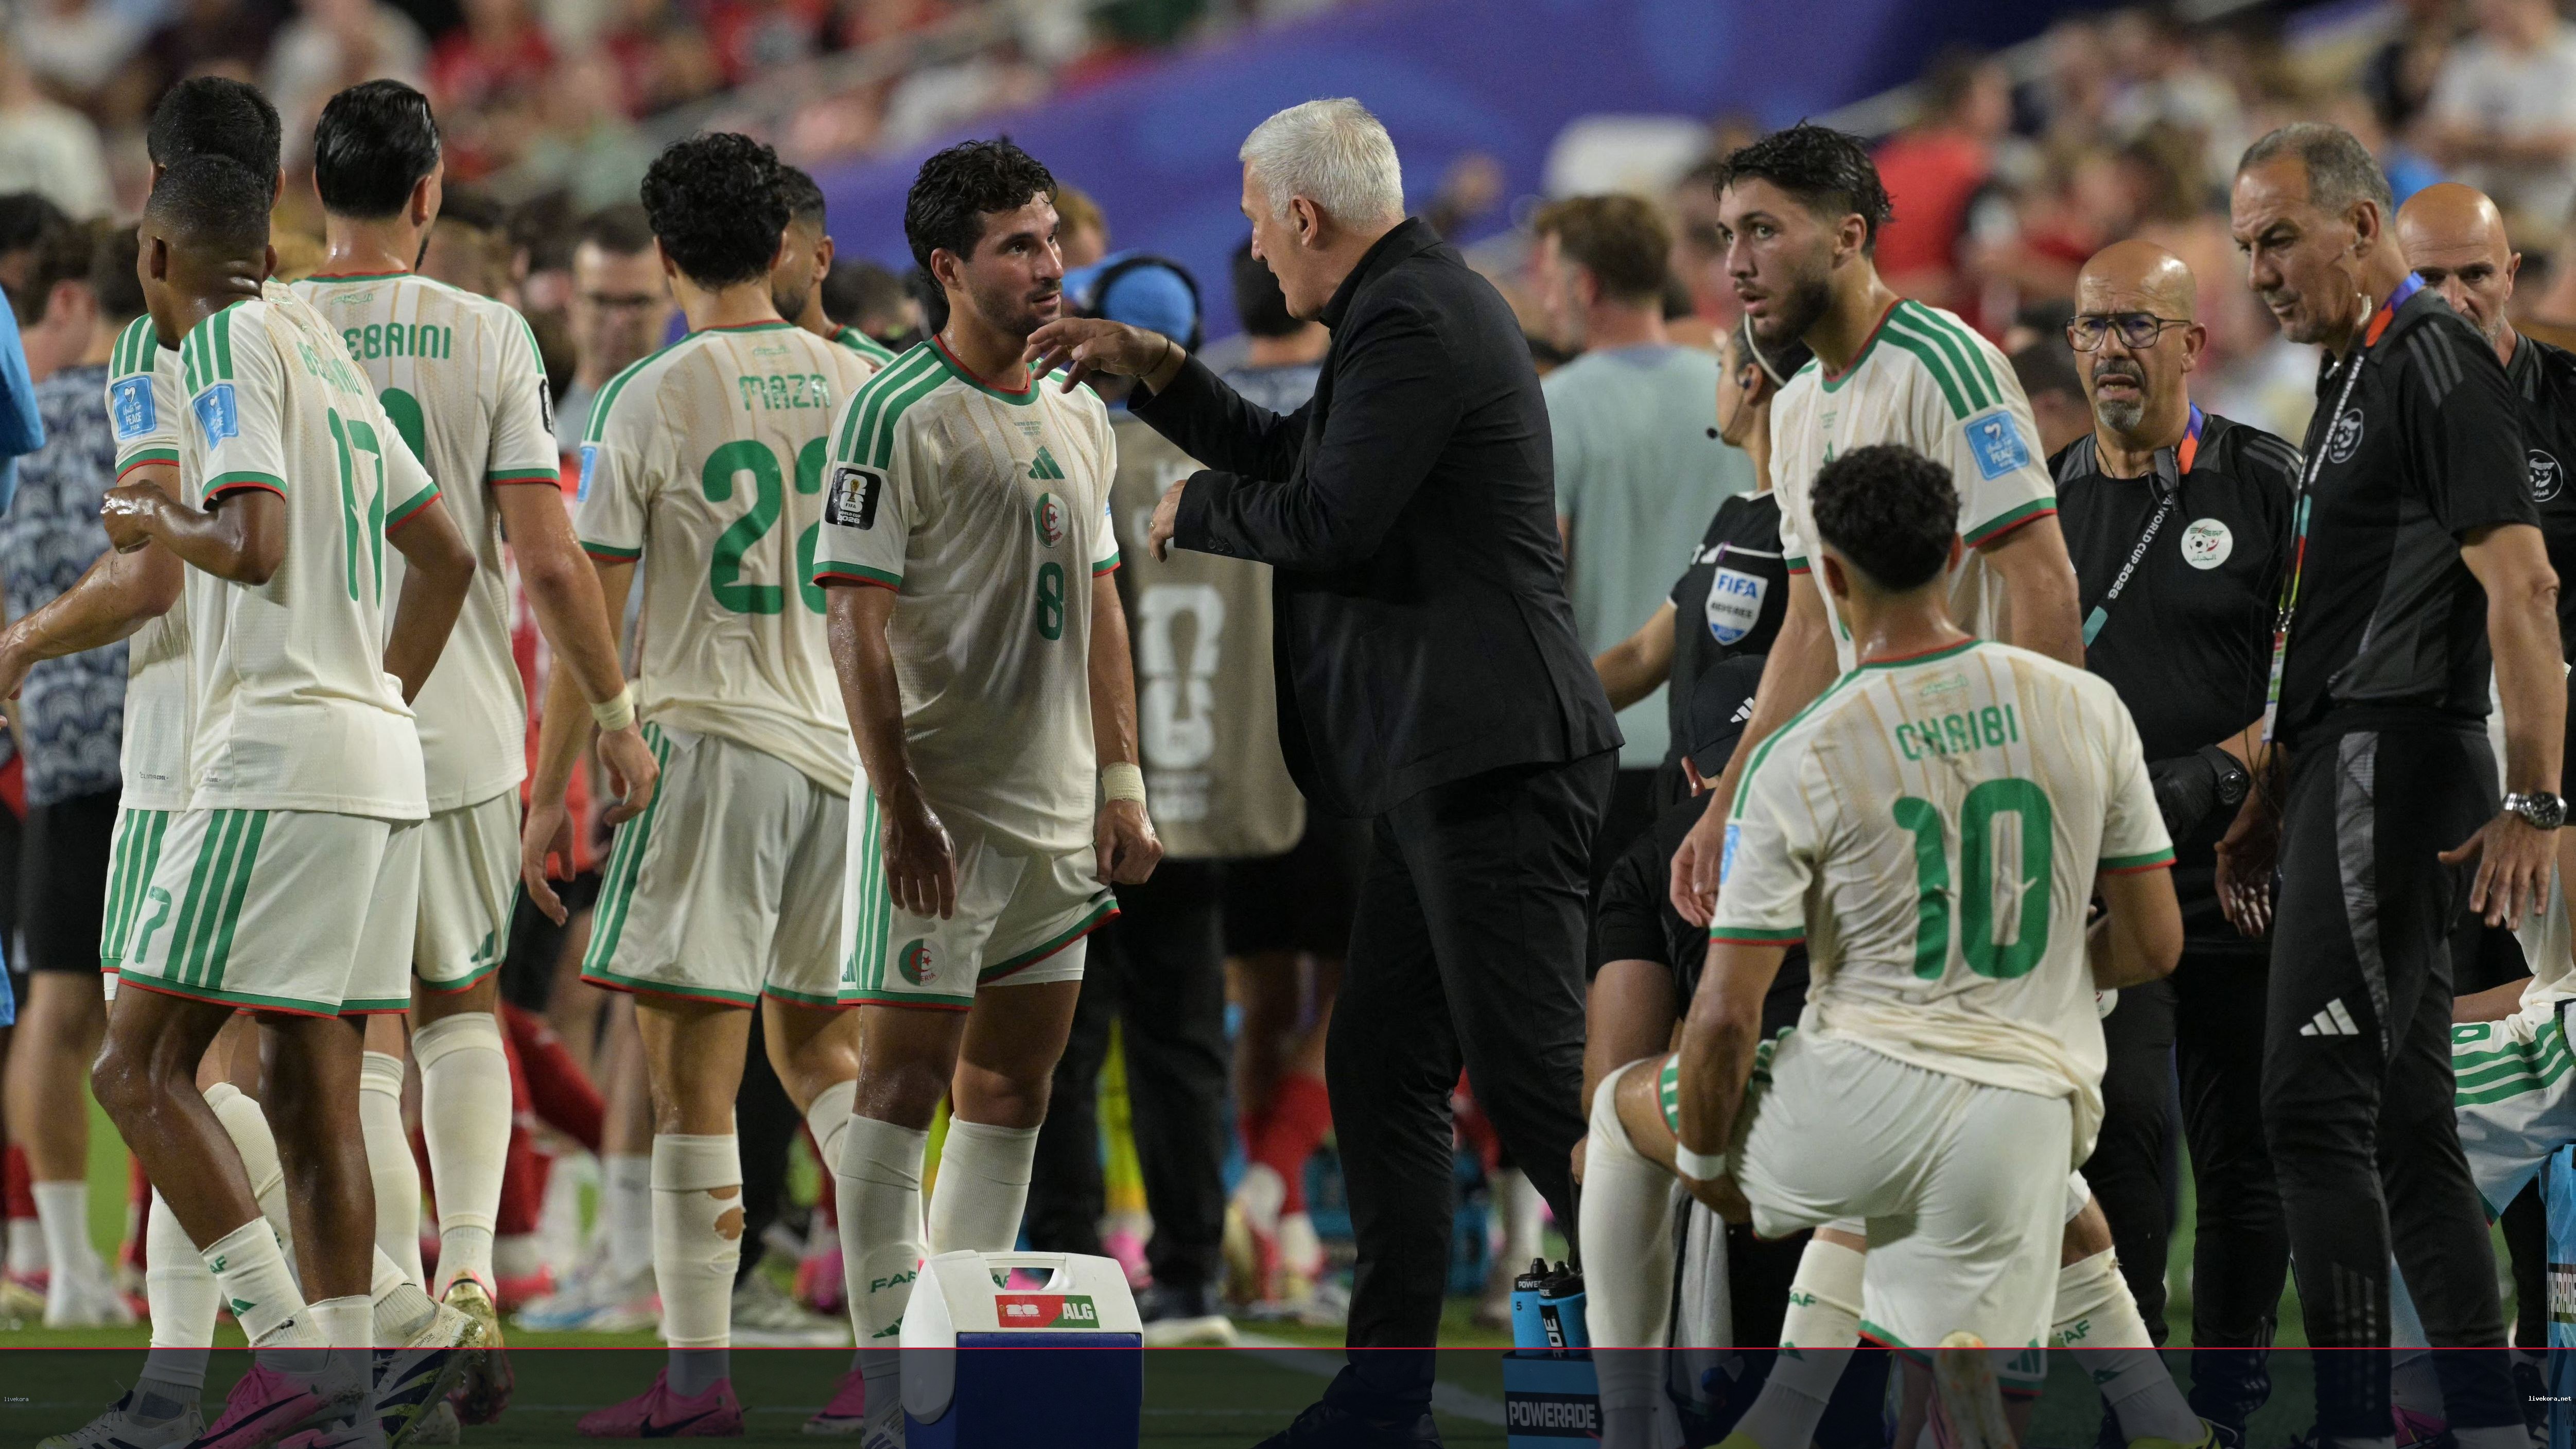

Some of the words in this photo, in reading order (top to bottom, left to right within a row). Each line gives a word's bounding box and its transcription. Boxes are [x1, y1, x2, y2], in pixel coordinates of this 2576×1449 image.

[343, 322, 450, 361] EBAINI
[739, 373, 831, 410] MAZA
[126, 412, 142, 425] PEACE
[327, 407, 382, 609] 17
[837, 515, 860, 524] 2026
[2142, 507, 2169, 544] WORLD
[2131, 542, 2147, 565] CUP
[1718, 574, 1757, 600] FIFA
[2108, 563, 2134, 600] 2026
[1036, 562, 1064, 640] 8
[1896, 703, 2018, 761] CHAIBI
[1893, 778, 2051, 979] 10
[871, 1270, 916, 1293] FAF
[1006, 1304, 1039, 1315] 26
[1062, 1303, 1094, 1320] ALG
[1516, 1302, 1522, 1311] 5
[1790, 1293, 1817, 1307] AF
[2061, 1319, 2091, 1344] AF
[1508, 1401, 1597, 1429] POWERADE
